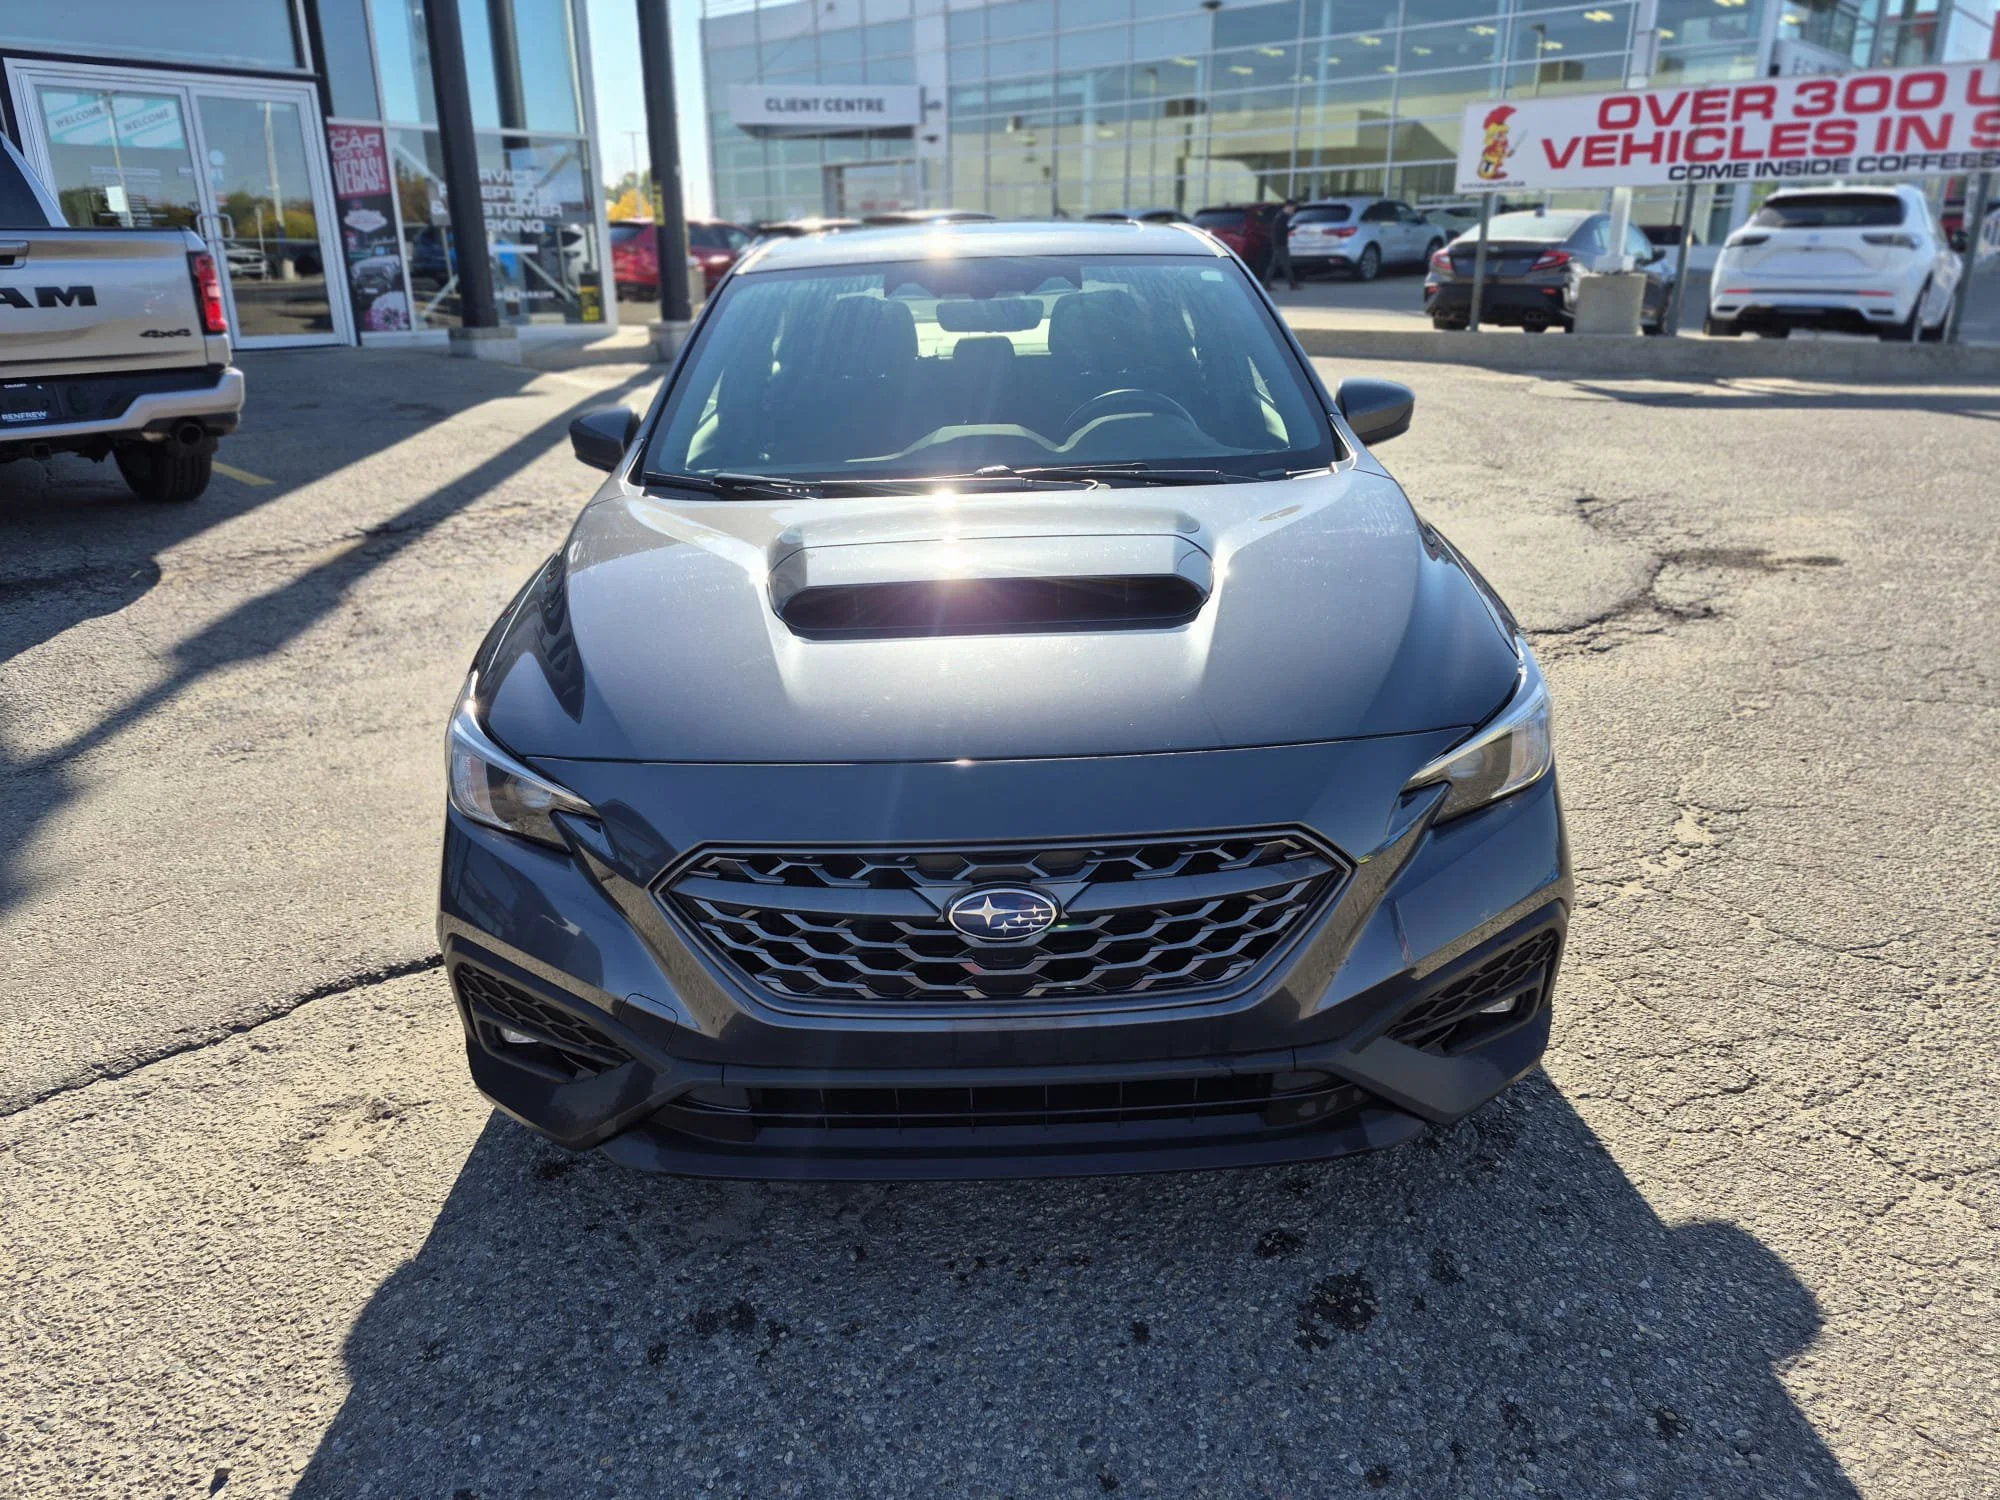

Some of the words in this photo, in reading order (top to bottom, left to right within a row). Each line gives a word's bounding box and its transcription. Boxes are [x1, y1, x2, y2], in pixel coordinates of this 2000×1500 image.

[764, 97, 820, 113] CLIENT
[823, 97, 885, 113] CENTRE
[1597, 85, 1777, 130] OVER
[1792, 72, 1948, 118] 300
[123, 107, 170, 131] WELCOME
[331, 133, 381, 152] CAR
[1541, 119, 1859, 169] VEHICLES
[1874, 113, 1955, 153] IN
[333, 156, 387, 195] VEGAS!
[1668, 162, 1750, 181] COME
[1754, 157, 1850, 178] INSIDE
[482, 201, 563, 218] STOMER
[484, 218, 546, 233] RKING
[0, 285, 98, 309] AM
[1, 411, 47, 420] RENFREW
